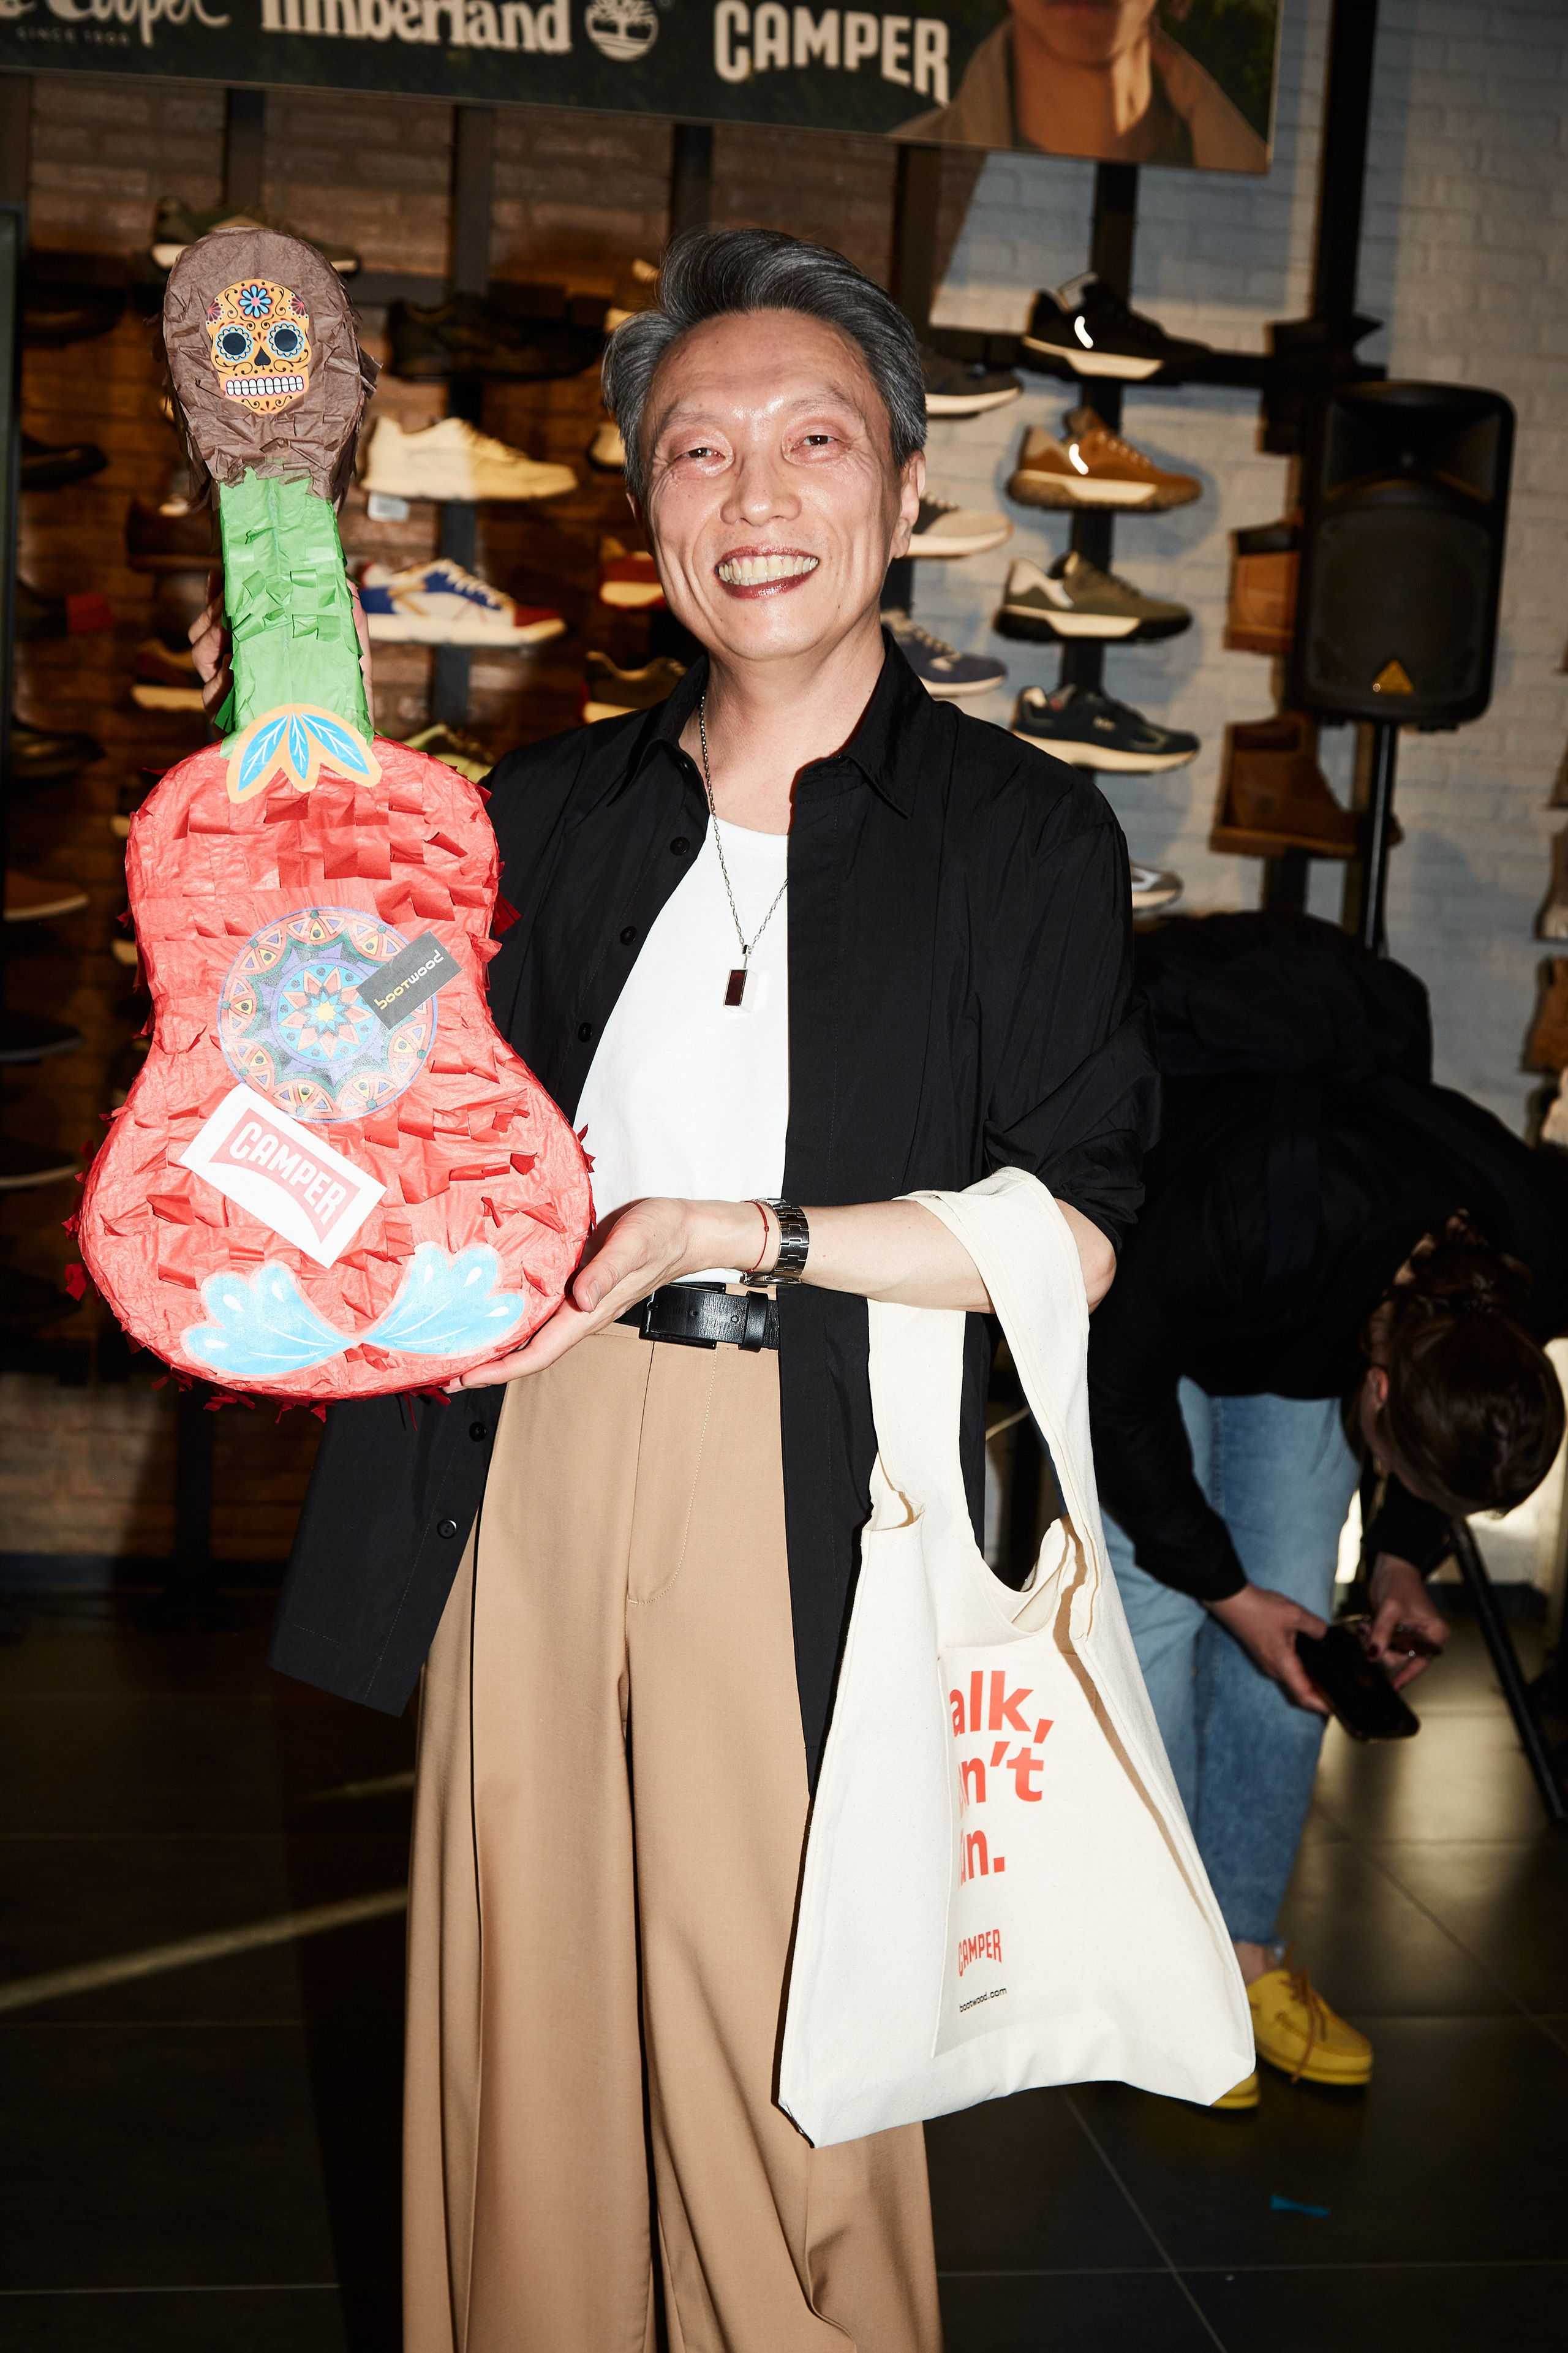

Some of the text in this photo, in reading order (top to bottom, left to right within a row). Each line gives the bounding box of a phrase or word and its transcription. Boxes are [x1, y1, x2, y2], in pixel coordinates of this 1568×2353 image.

[714, 0, 951, 108] CAMPER
[230, 1122, 347, 1225] CAMPER
[959, 1742, 1044, 1819] n't
[959, 1828, 1005, 1888] n.
[959, 1928, 1002, 1977] CAMPER
[959, 1987, 1007, 2013] bootwood.com
